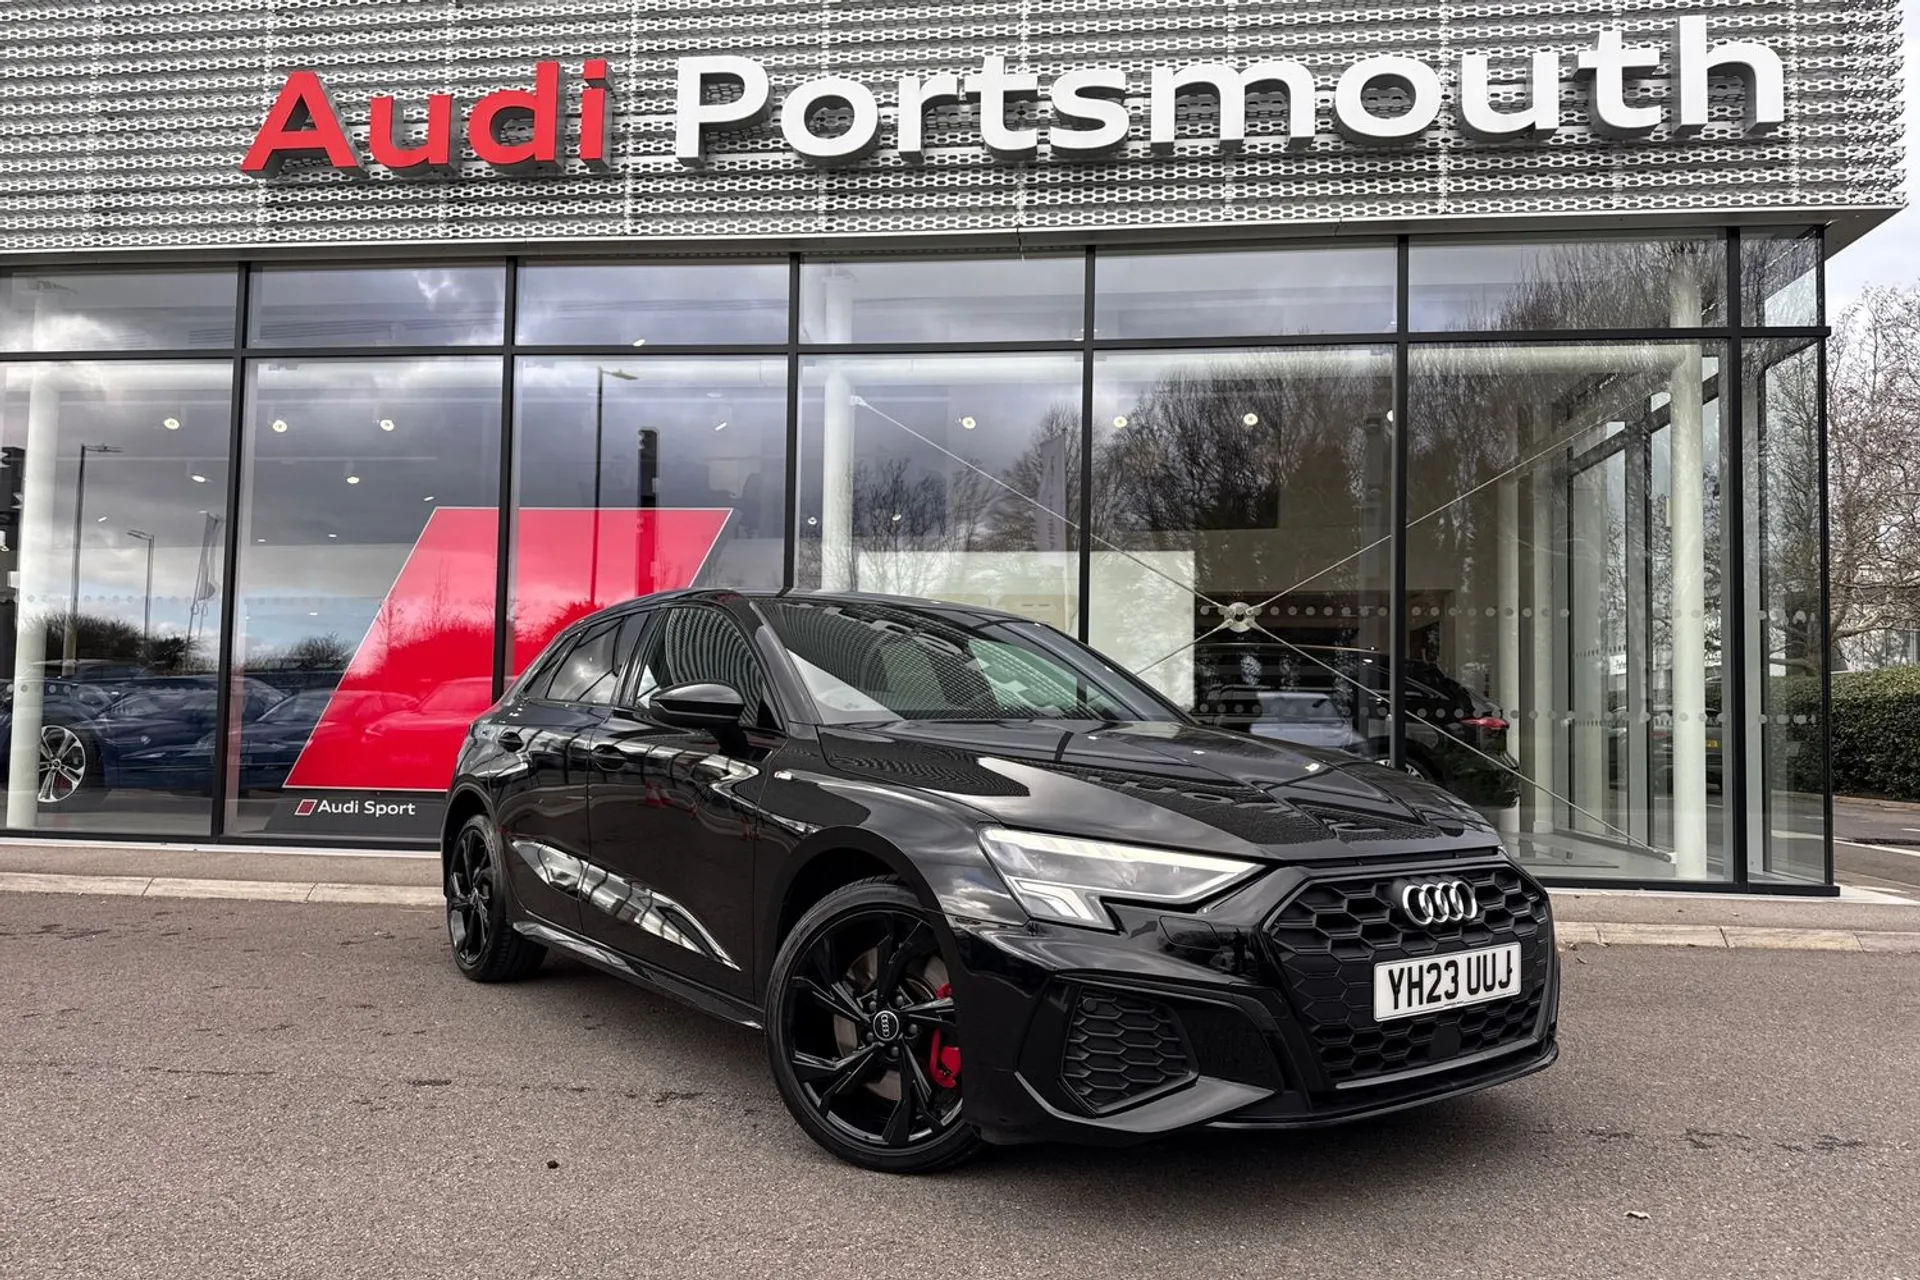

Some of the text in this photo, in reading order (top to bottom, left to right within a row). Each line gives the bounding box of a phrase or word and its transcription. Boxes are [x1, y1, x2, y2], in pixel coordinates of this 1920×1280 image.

[240, 14, 1786, 174] Audi Portsmouth
[317, 799, 416, 818] Audi Sport
[1387, 950, 1513, 1010] YH23 UUJ
